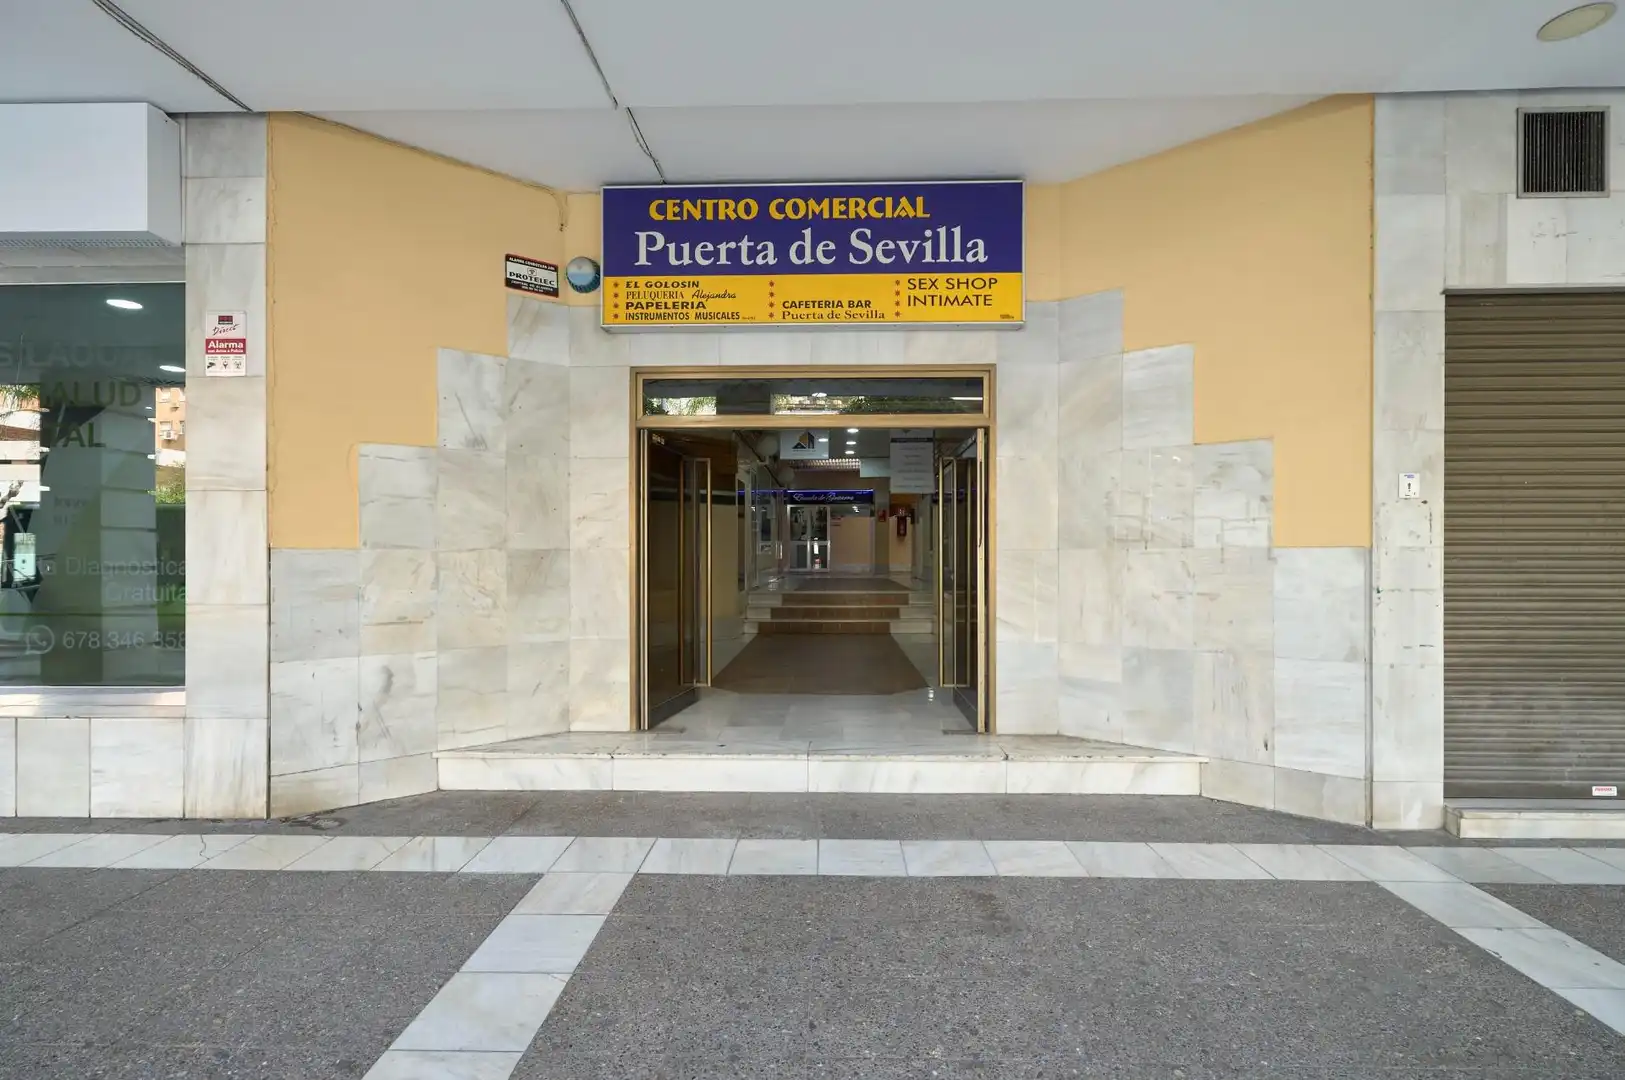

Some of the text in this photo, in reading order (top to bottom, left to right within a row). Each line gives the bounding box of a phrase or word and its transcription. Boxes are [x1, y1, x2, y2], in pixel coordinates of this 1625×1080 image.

[649, 196, 931, 221] CENTRO COMERCIAL
[634, 226, 988, 266] Puerta de Sevilla
[509, 271, 555, 286] PROTELEC
[907, 277, 998, 290] SEX SHOP
[626, 289, 736, 301] PELUQUERIA Alejandra
[907, 294, 992, 306] INTIMATE
[625, 301, 706, 310] PAPELERIA
[782, 300, 871, 309] CAFETERIA BAR
[625, 312, 690, 320] INSTRUMENTOS
[694, 312, 740, 320] MUSICALES
[782, 309, 885, 320] Puerta de Sevilla
[208, 340, 243, 348] Alarma
[105, 582, 186, 601] Gratuita
[63, 631, 100, 648] 678
[107, 631, 145, 648] 346
